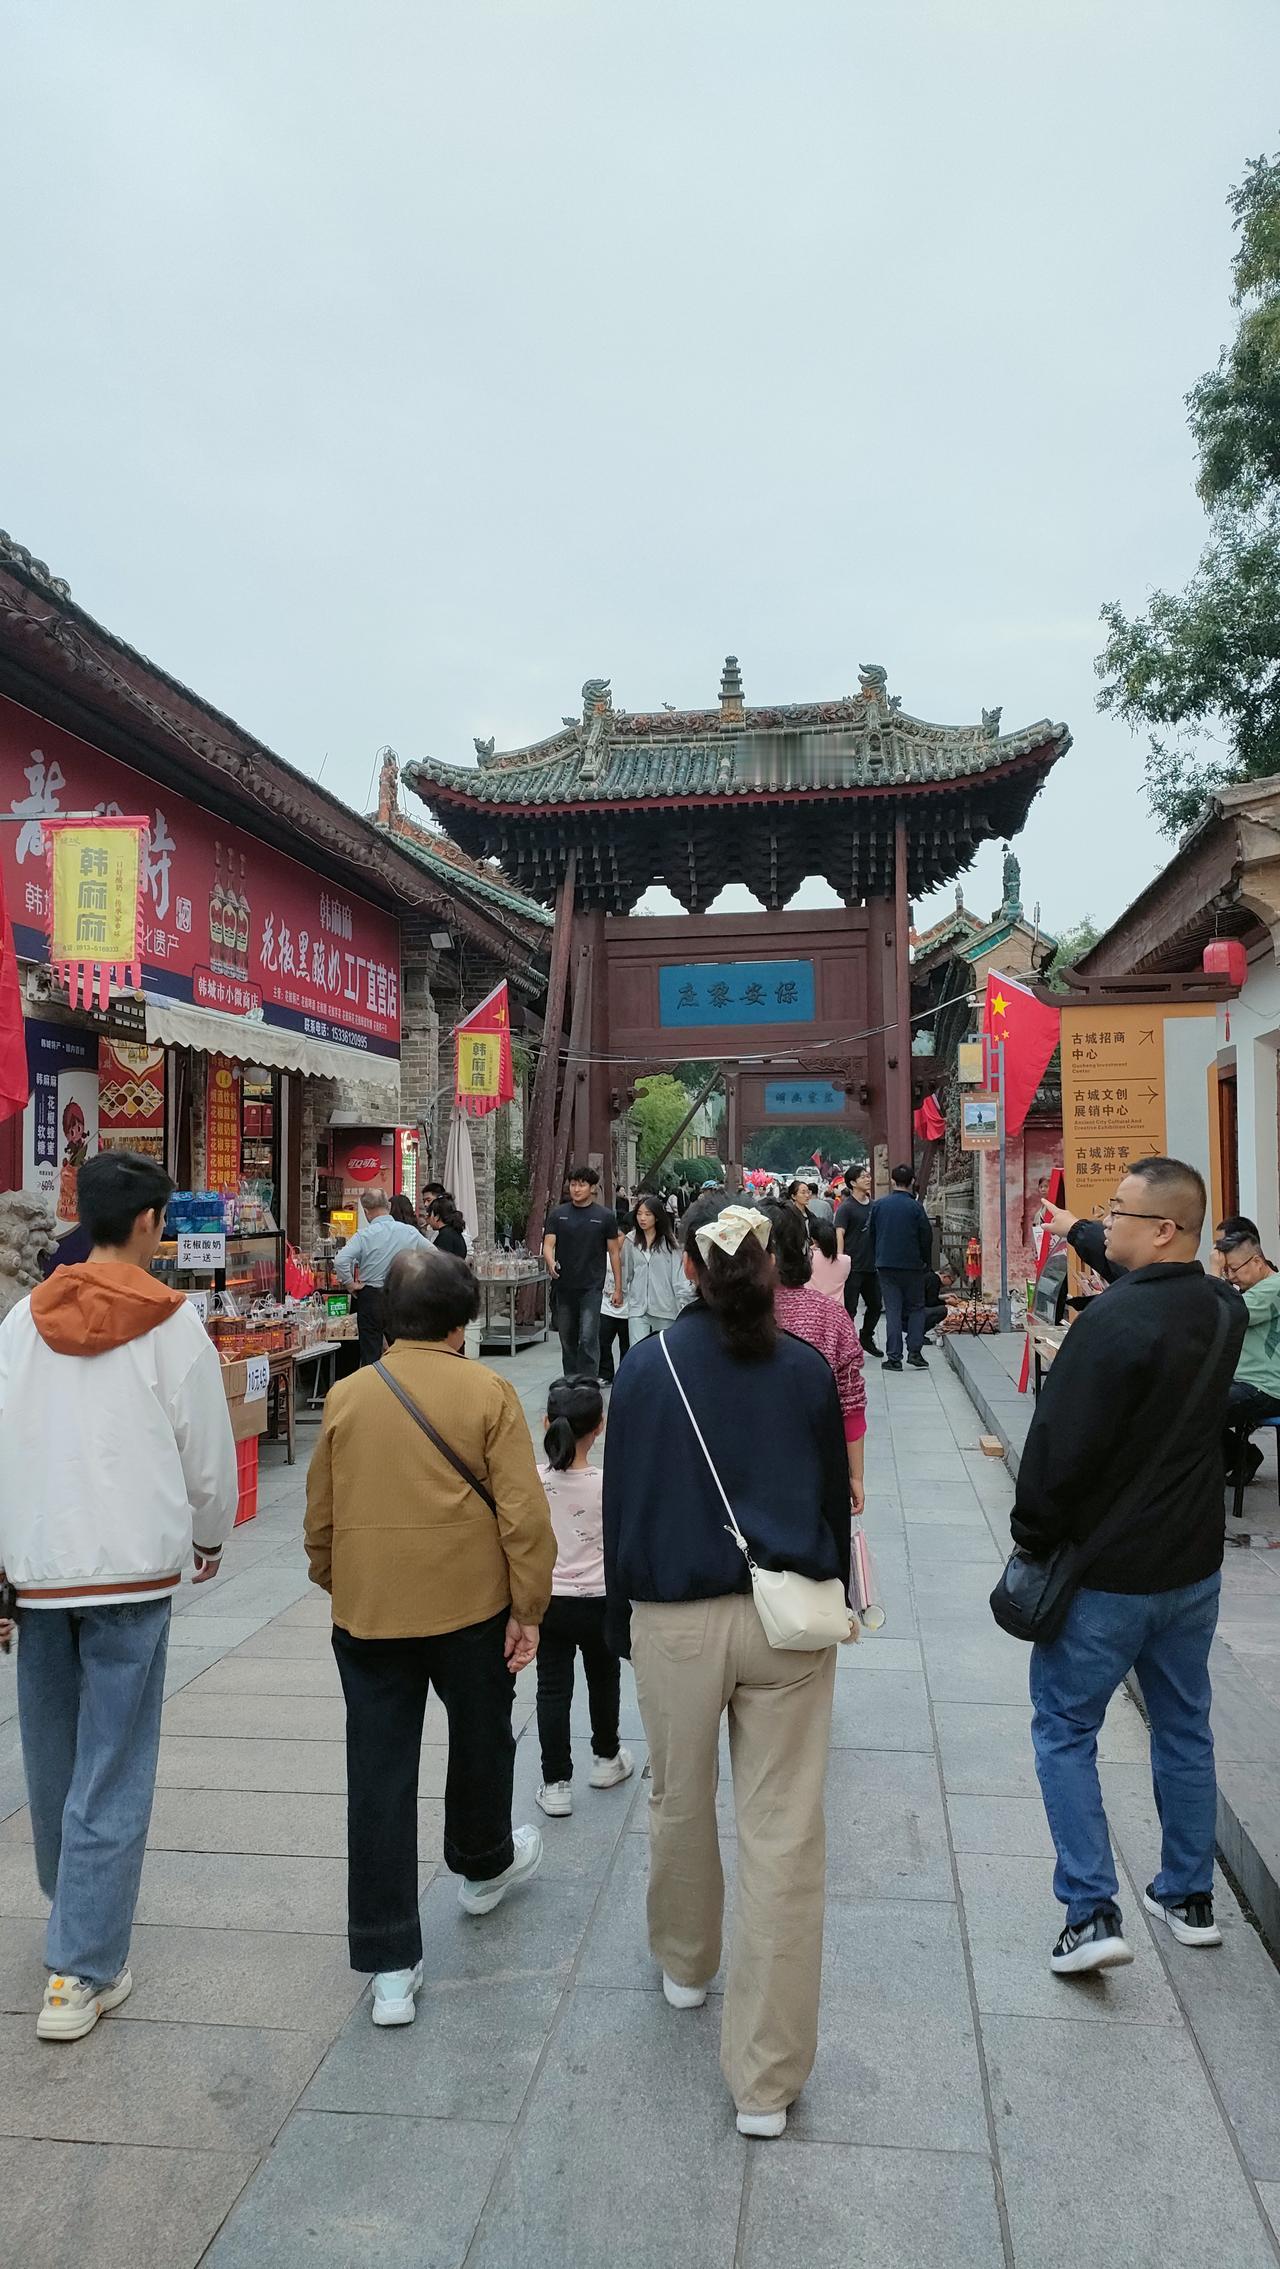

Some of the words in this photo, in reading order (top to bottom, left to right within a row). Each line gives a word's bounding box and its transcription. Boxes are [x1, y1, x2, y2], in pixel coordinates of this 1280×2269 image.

[76, 847, 108, 943] 韩麻麻
[319, 891, 353, 942] 韩麻麻
[1071, 1031, 1126, 1045] 古城招商
[1072, 1048, 1098, 1060] 中心
[472, 1042, 487, 1087] 韩麻麻
[36, 1072, 57, 1088] 韩麻麻
[1073, 1088, 1128, 1102] 古城文创
[210, 1105, 237, 1121] 花椒酸奶
[1074, 1104, 1129, 1117] 展销中心
[46, 1095, 56, 1156] 花椒蜂蜜
[37, 1125, 46, 1156] 软糖
[210, 1138, 237, 1152] 花椒芽菜
[1075, 1146, 1130, 1159] 古城游客
[210, 1154, 237, 1168] 花椒锅巴
[347, 1157, 379, 1169] 可口可乐
[1076, 1162, 1129, 1175] 服务中心
[209, 1170, 237, 1184] 花椒啤酒
[183, 1239, 222, 1250] 花椒酸奶
[183, 1252, 222, 1263] 买一送一
